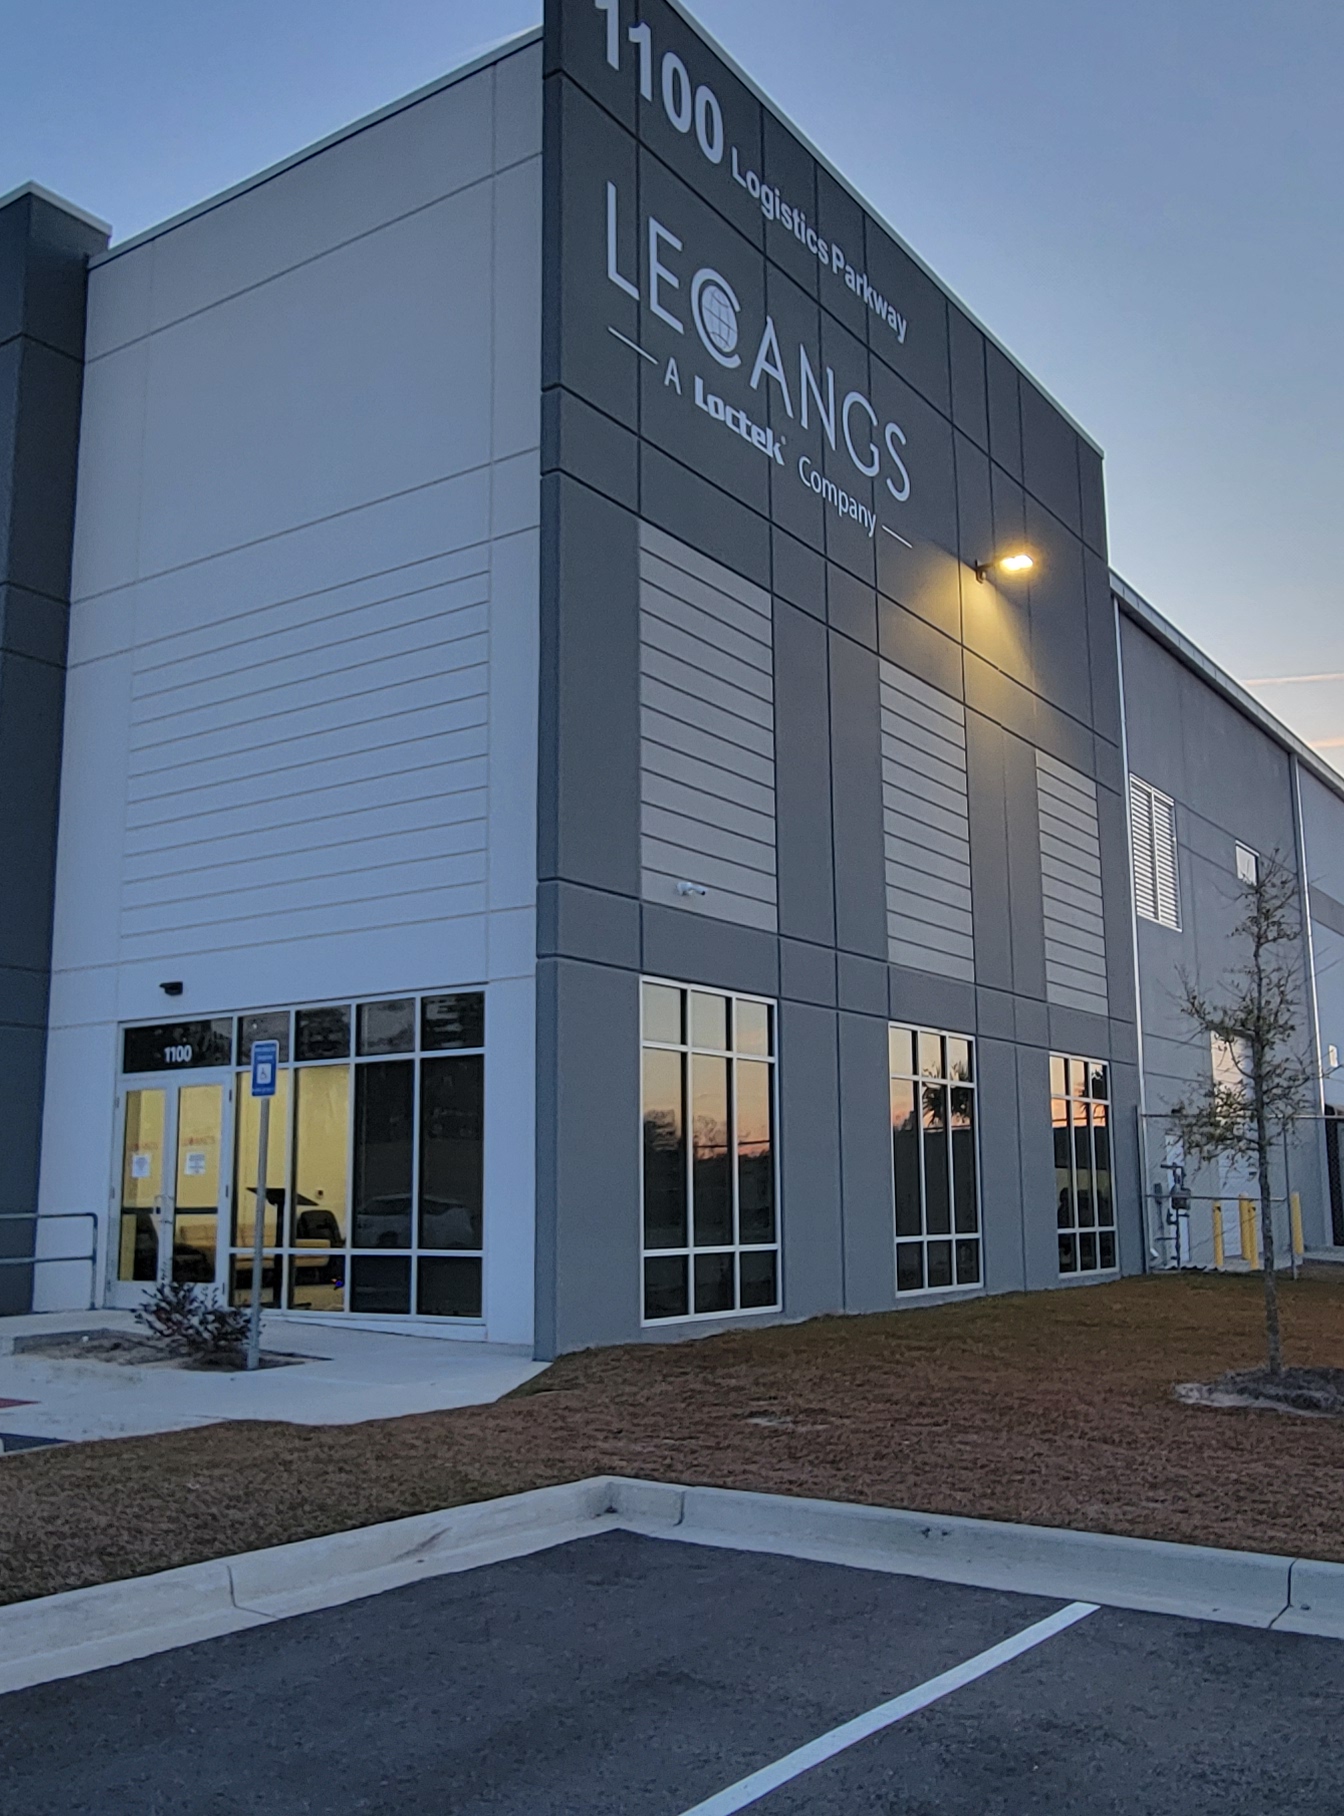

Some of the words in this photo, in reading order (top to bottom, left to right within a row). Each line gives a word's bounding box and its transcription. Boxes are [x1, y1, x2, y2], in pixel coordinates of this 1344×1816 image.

[595, 0, 724, 165] 1100
[732, 146, 829, 265] Logistics
[831, 243, 908, 344] Parkway
[664, 357, 681, 394] A
[694, 375, 785, 465] Loctek
[798, 455, 877, 537] Company
[164, 1044, 193, 1063] 1100
